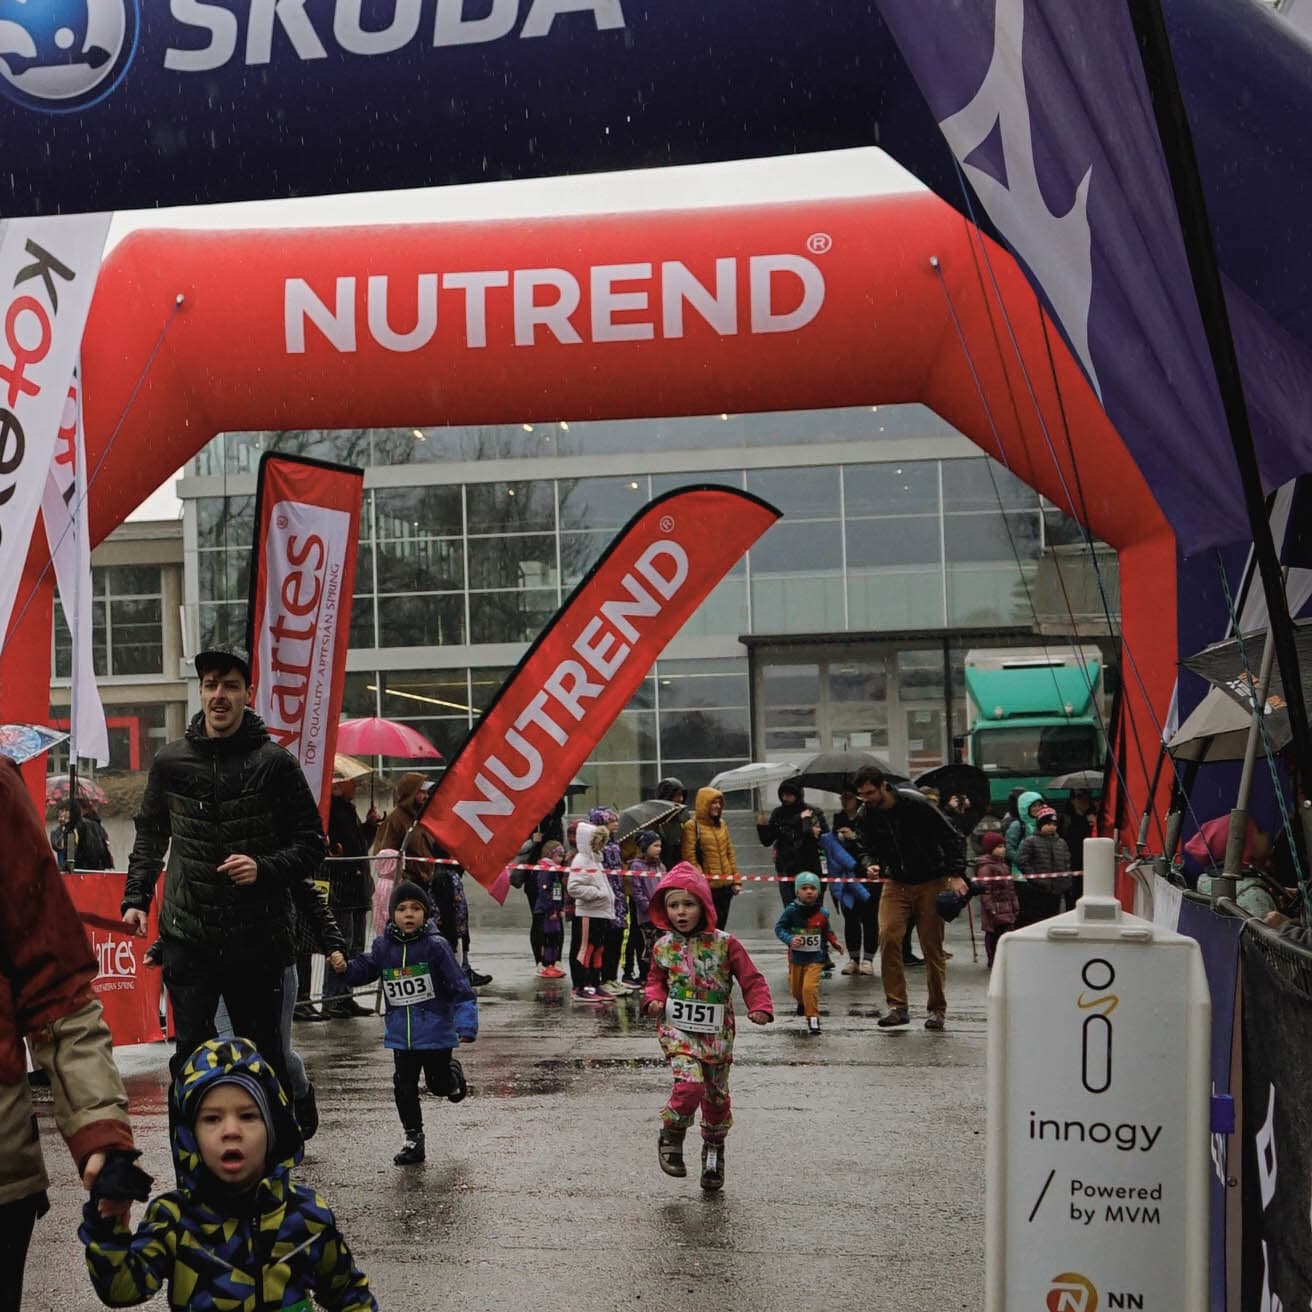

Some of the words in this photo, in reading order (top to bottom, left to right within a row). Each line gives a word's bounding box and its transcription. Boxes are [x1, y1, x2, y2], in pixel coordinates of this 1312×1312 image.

[327, 563, 340, 609] SPRING
[318, 614, 333, 676] ARTESIAN
[310, 680, 324, 737] QUALITY
[305, 741, 317, 765] TOP
[387, 977, 427, 998] 3103
[672, 1001, 715, 1023] 3151
[1029, 1111, 1162, 1151] innogy
[1070, 1179, 1163, 1200] Powered
[1070, 1203, 1095, 1225] by
[1105, 1207, 1161, 1225] MVM
[1107, 1292, 1144, 1310] NN
